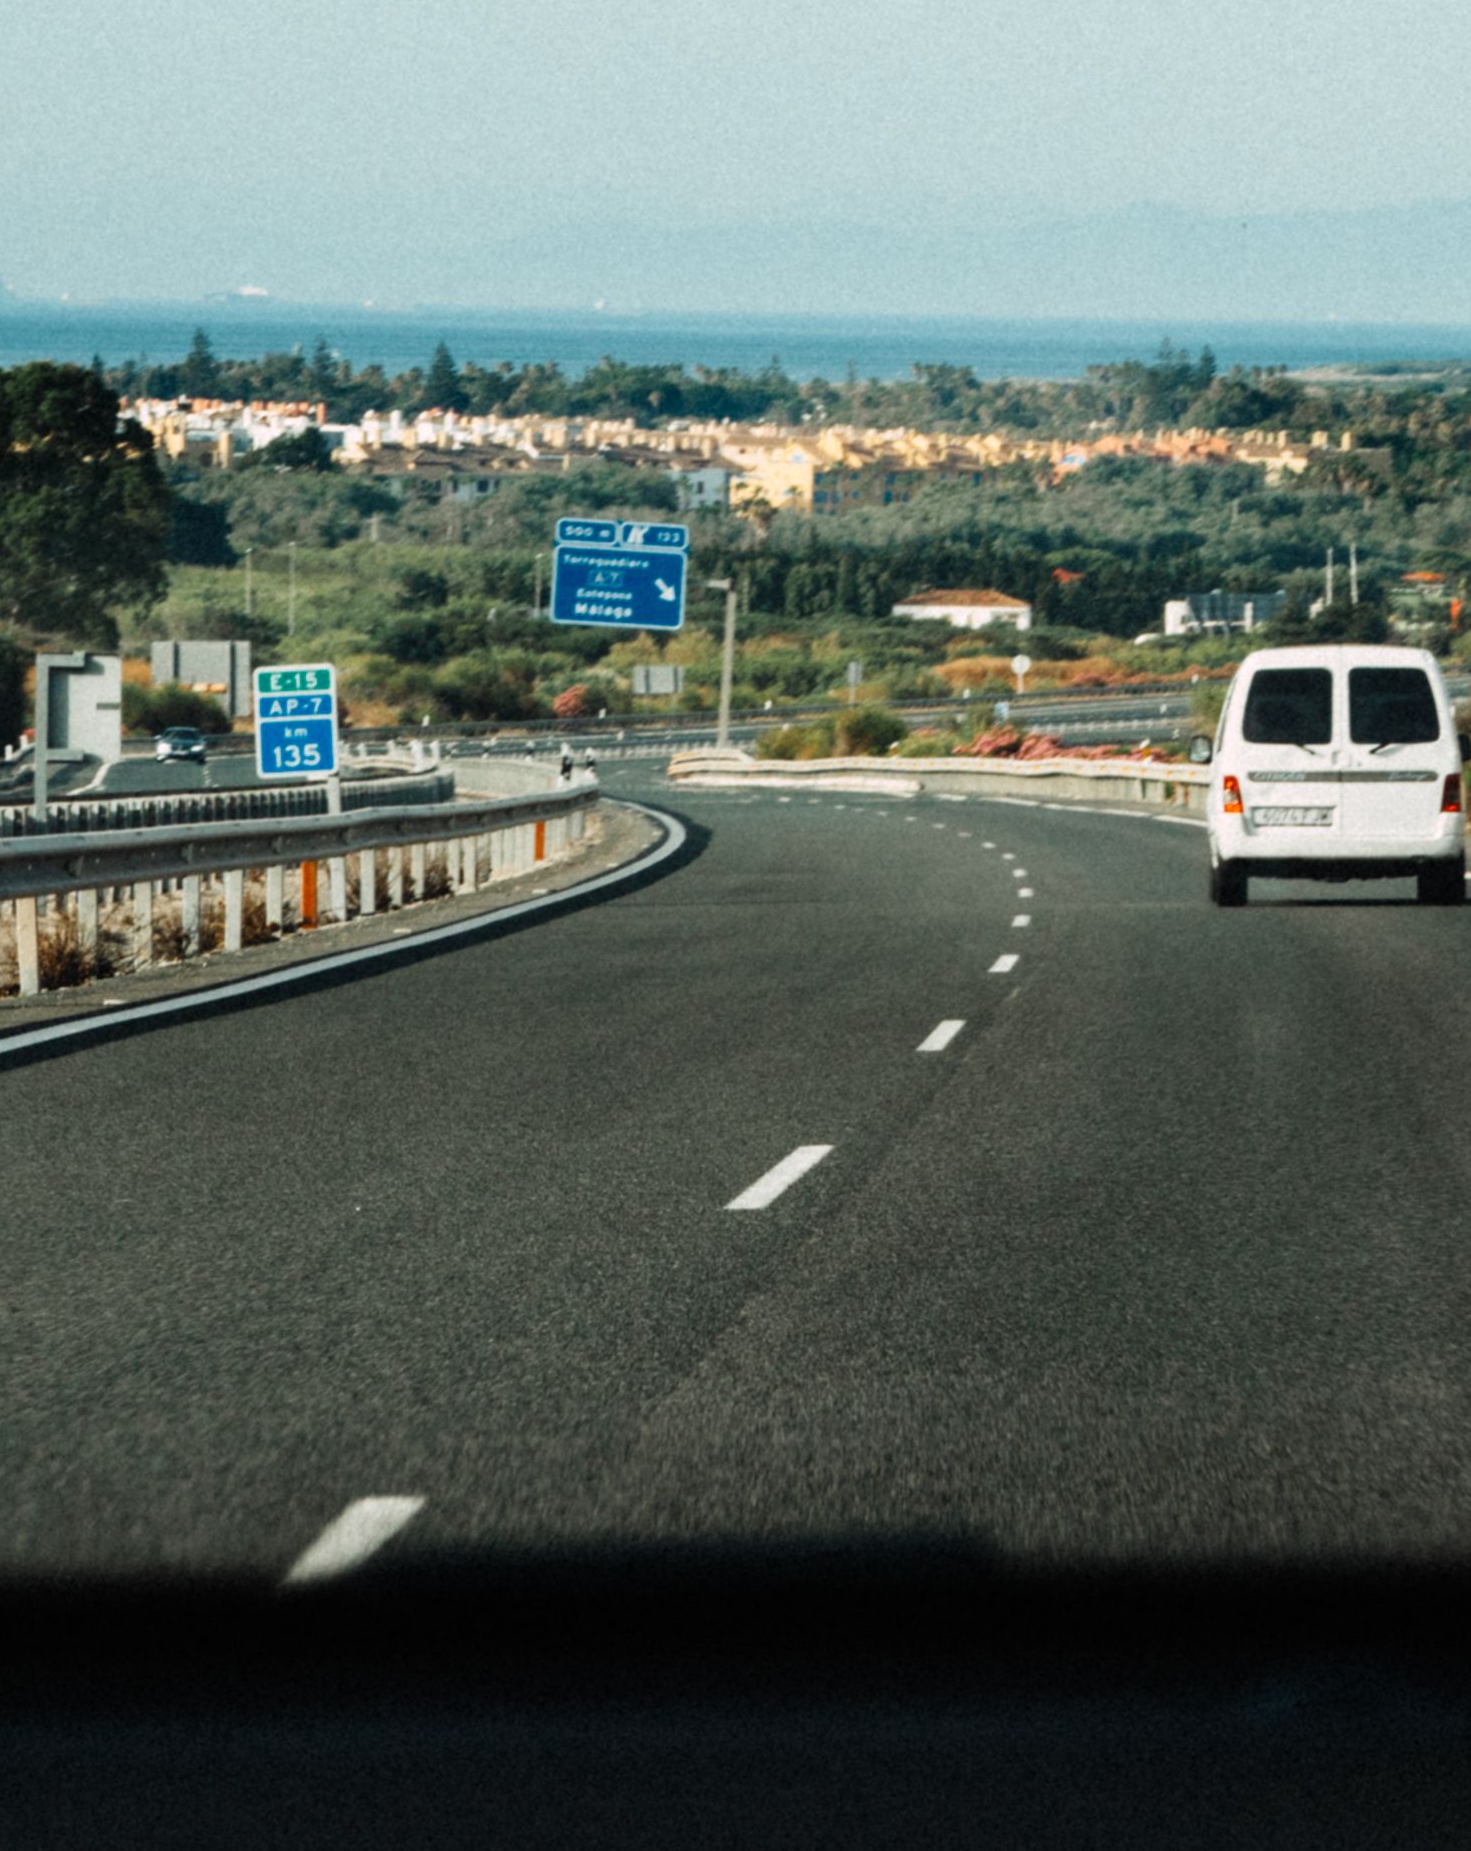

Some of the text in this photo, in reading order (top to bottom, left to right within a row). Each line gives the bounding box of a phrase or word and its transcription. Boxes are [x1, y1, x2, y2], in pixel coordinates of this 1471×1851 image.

[270, 672, 318, 690] E-15
[269, 697, 322, 716] AP-7
[285, 726, 308, 738] km
[273, 743, 321, 768] 135
